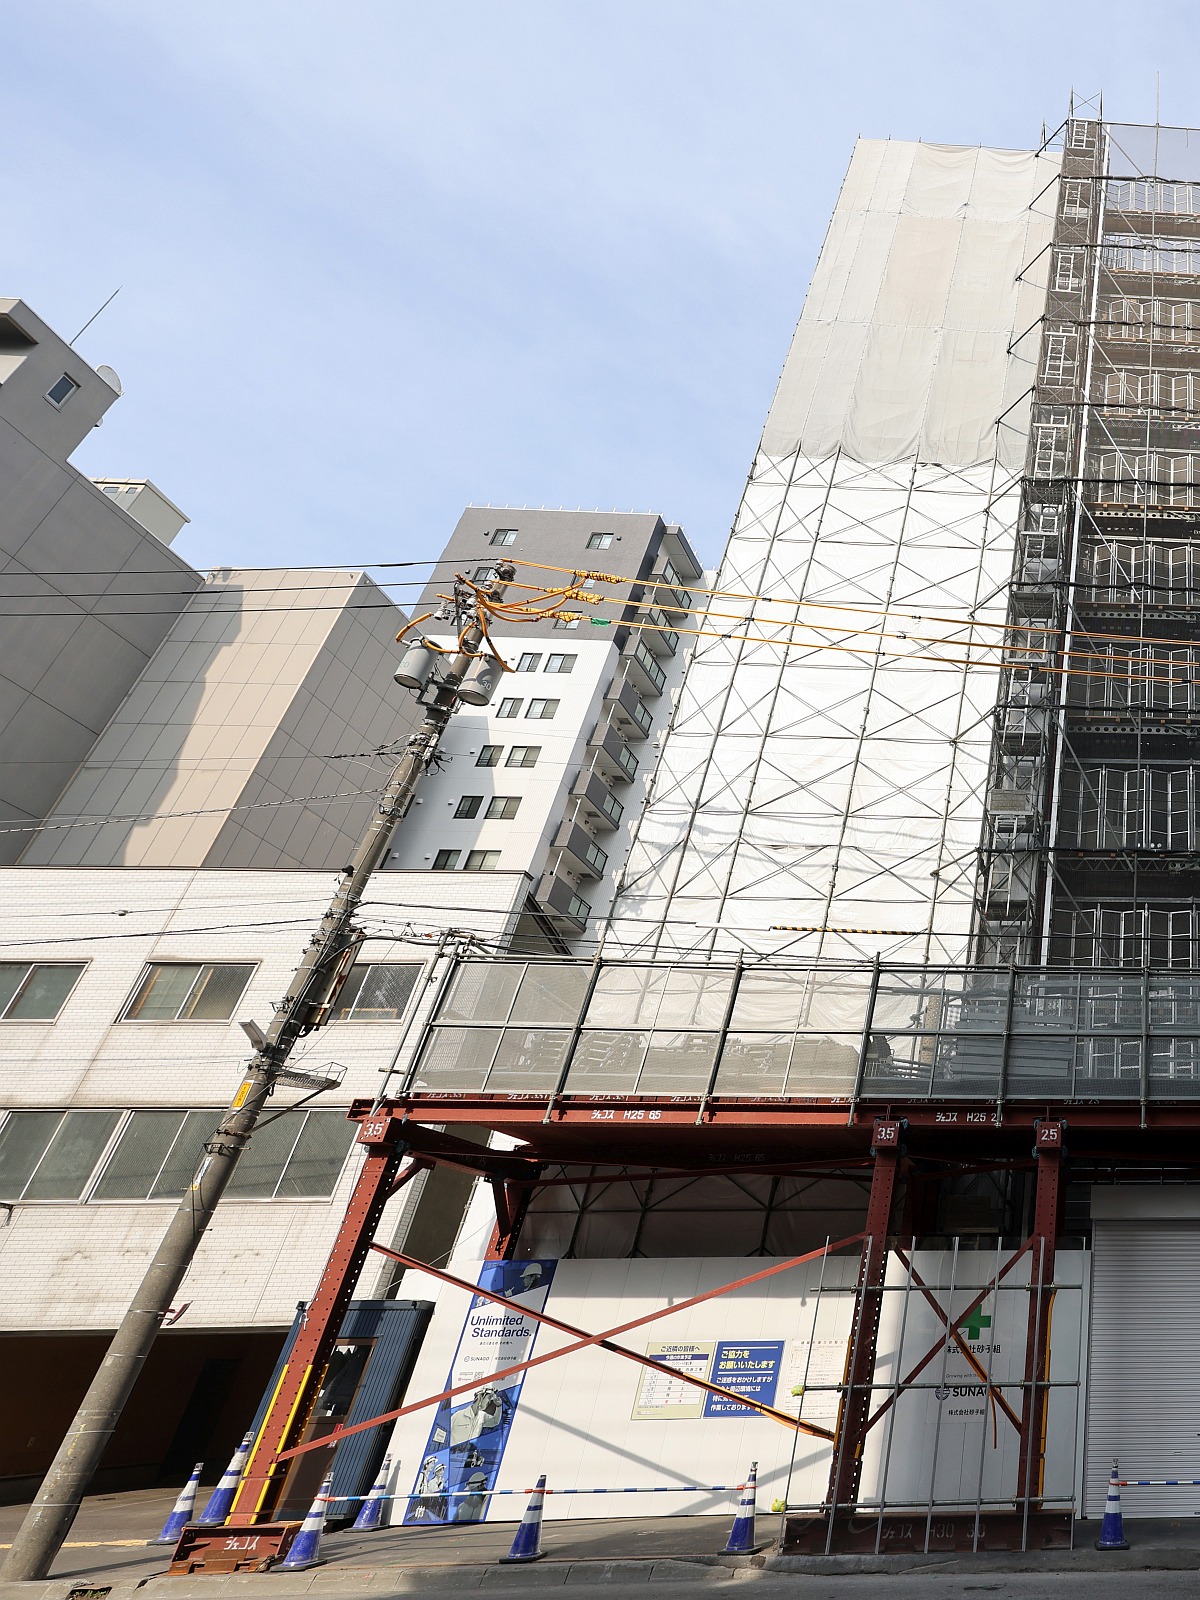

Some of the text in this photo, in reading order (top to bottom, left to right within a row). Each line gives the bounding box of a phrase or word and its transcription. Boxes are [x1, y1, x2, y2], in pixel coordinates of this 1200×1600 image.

[481, 680, 492, 691] 30
[623, 1109, 646, 1120] H25
[966, 1112, 987, 1122] H25
[470, 1315, 524, 1326] Unlimited
[471, 1327, 532, 1338] Standards.
[661, 1345, 700, 1353] ご近隣の皆様へ
[946, 1345, 1001, 1354] 株式社砂子組
[721, 1350, 750, 1359] ご協力を
[718, 1361, 775, 1370] お願いいたします
[716, 1376, 773, 1384] ご迷惑をおかけしますが
[952, 1386, 1002, 1397] SUNA
